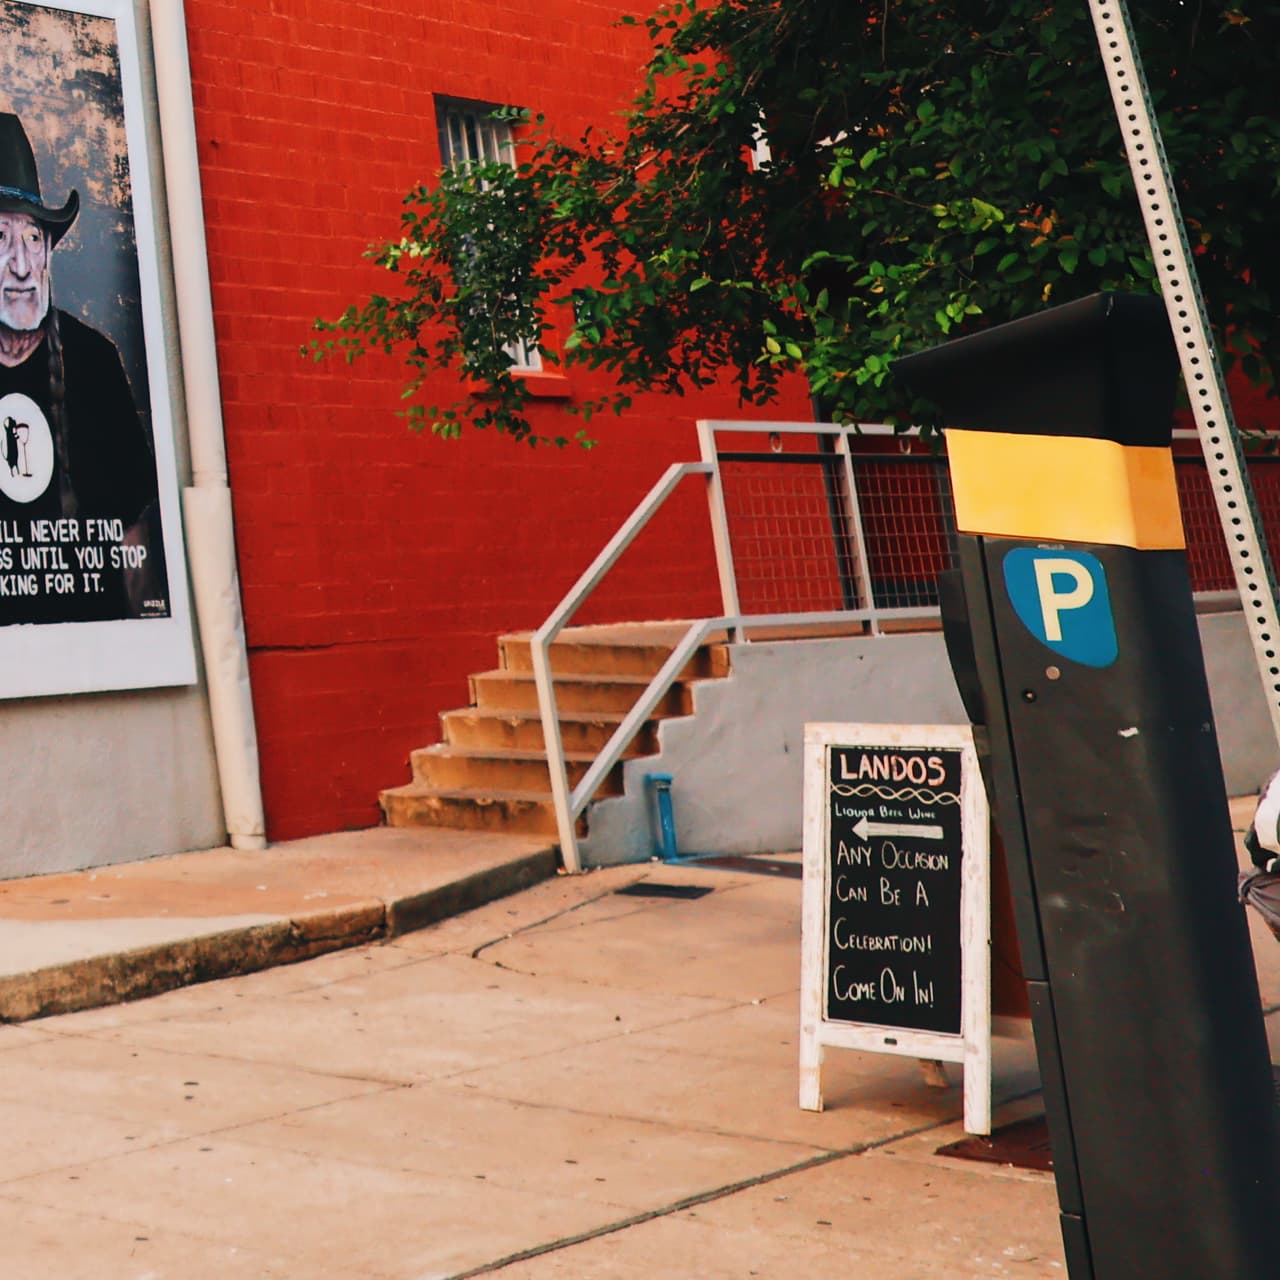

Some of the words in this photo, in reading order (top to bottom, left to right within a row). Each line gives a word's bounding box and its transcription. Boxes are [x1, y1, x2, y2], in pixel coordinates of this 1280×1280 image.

[30, 519, 80, 543] NEVER
[86, 519, 124, 542] FIND
[20, 547, 69, 570] UNTIL
[74, 546, 104, 569] YOU
[110, 545, 148, 569] STOP
[44, 573, 75, 594] FOR
[83, 573, 105, 593] IT.
[1033, 558, 1094, 641] P
[840, 753, 946, 787] LANDOS
[837, 840, 872, 867] ANY
[836, 874, 868, 902] CAN
[880, 876, 901, 906] BE
[915, 880, 929, 907] A
[833, 964, 876, 1001] COME
[880, 967, 905, 1004] ON
